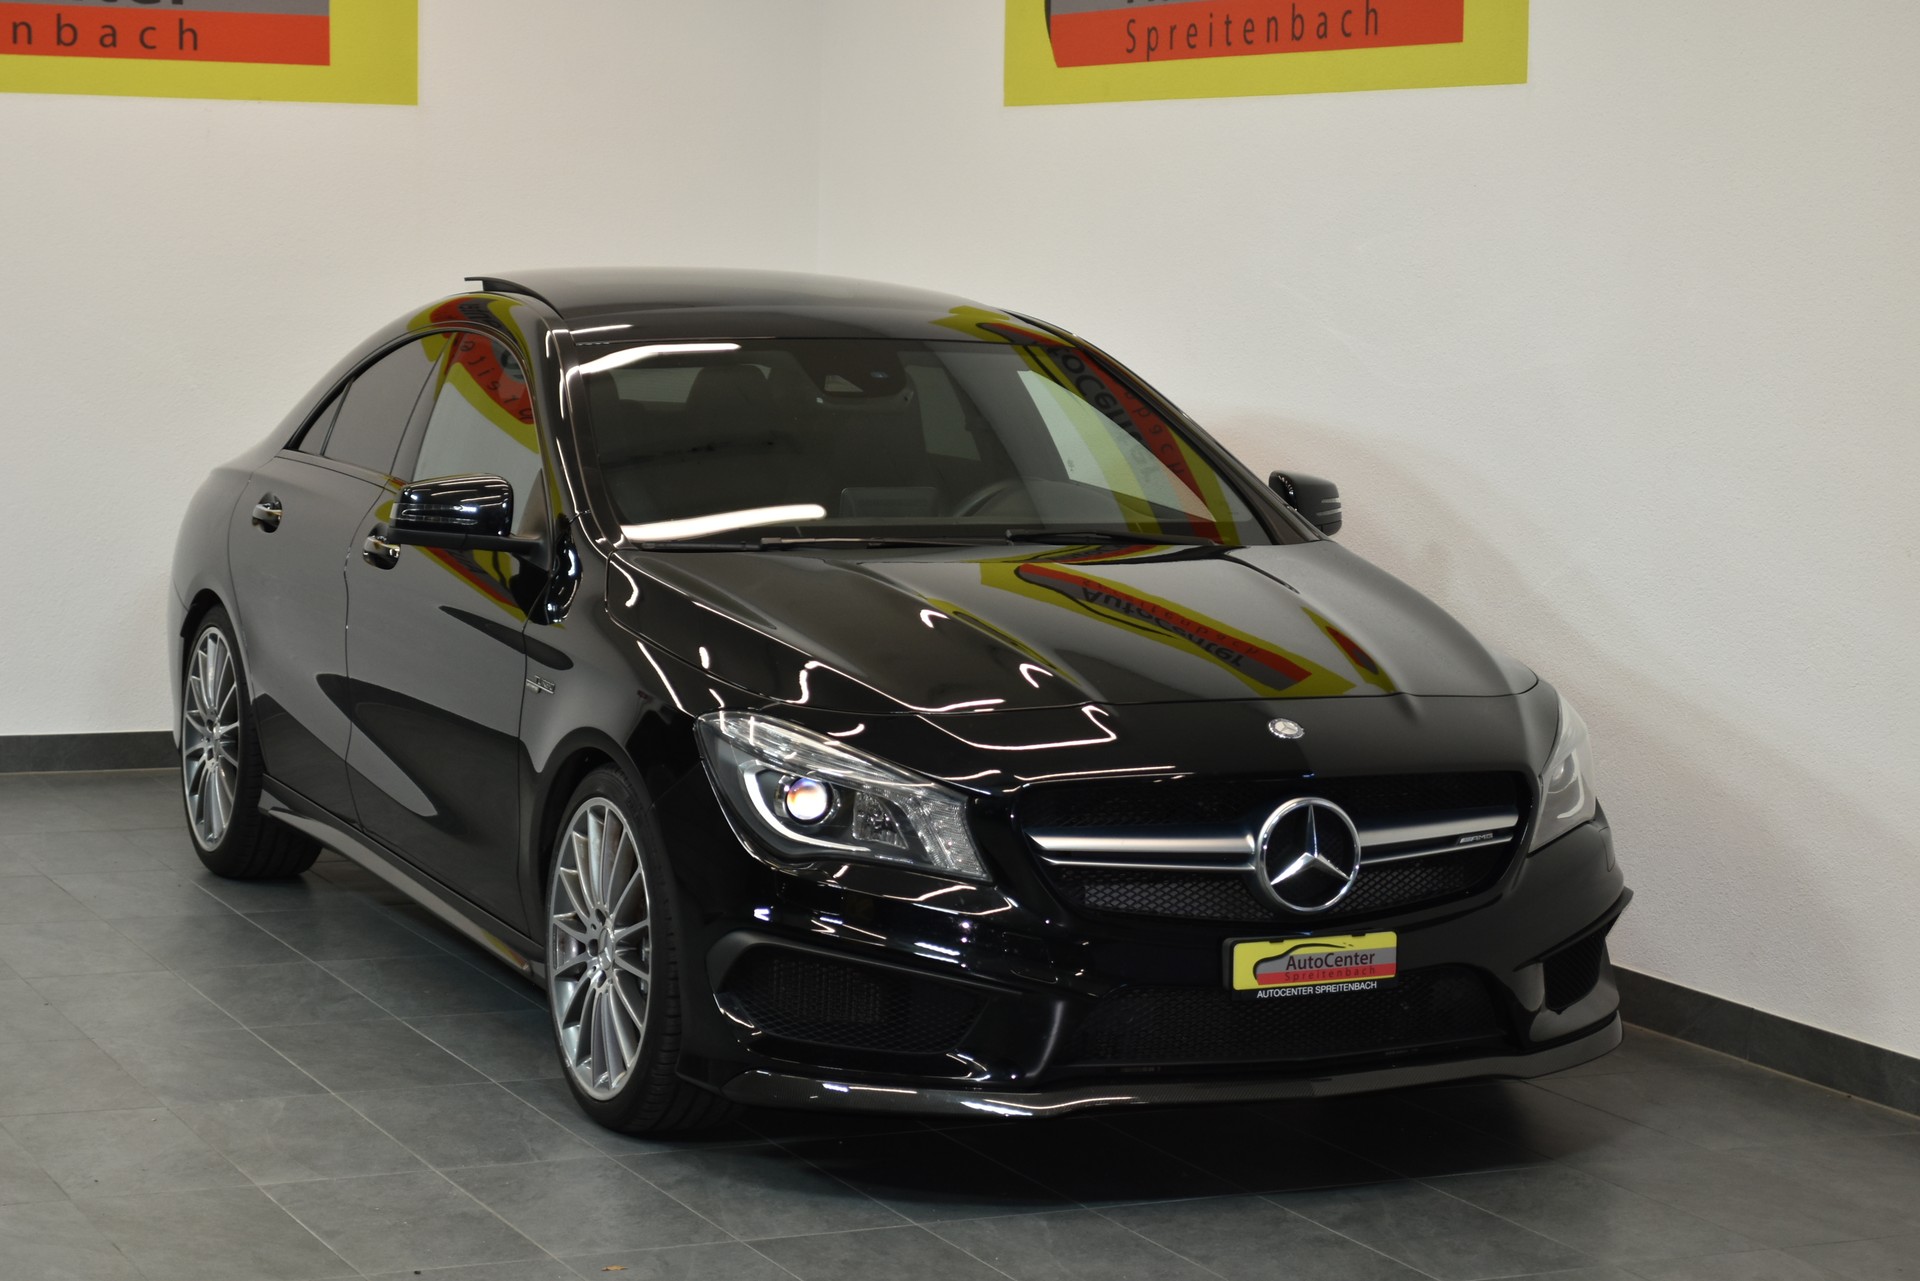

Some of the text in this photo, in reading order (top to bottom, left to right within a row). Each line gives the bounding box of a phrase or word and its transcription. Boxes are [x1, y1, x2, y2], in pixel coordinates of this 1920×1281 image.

[12, 13, 198, 51] nbach
[1126, 0, 1378, 61] Spreitenbach
[1286, 952, 1375, 971] AutoCenter
[1285, 967, 1375, 982] Spreitenbach
[1257, 981, 1377, 998] AUTOCENTER SPREITENBACH
